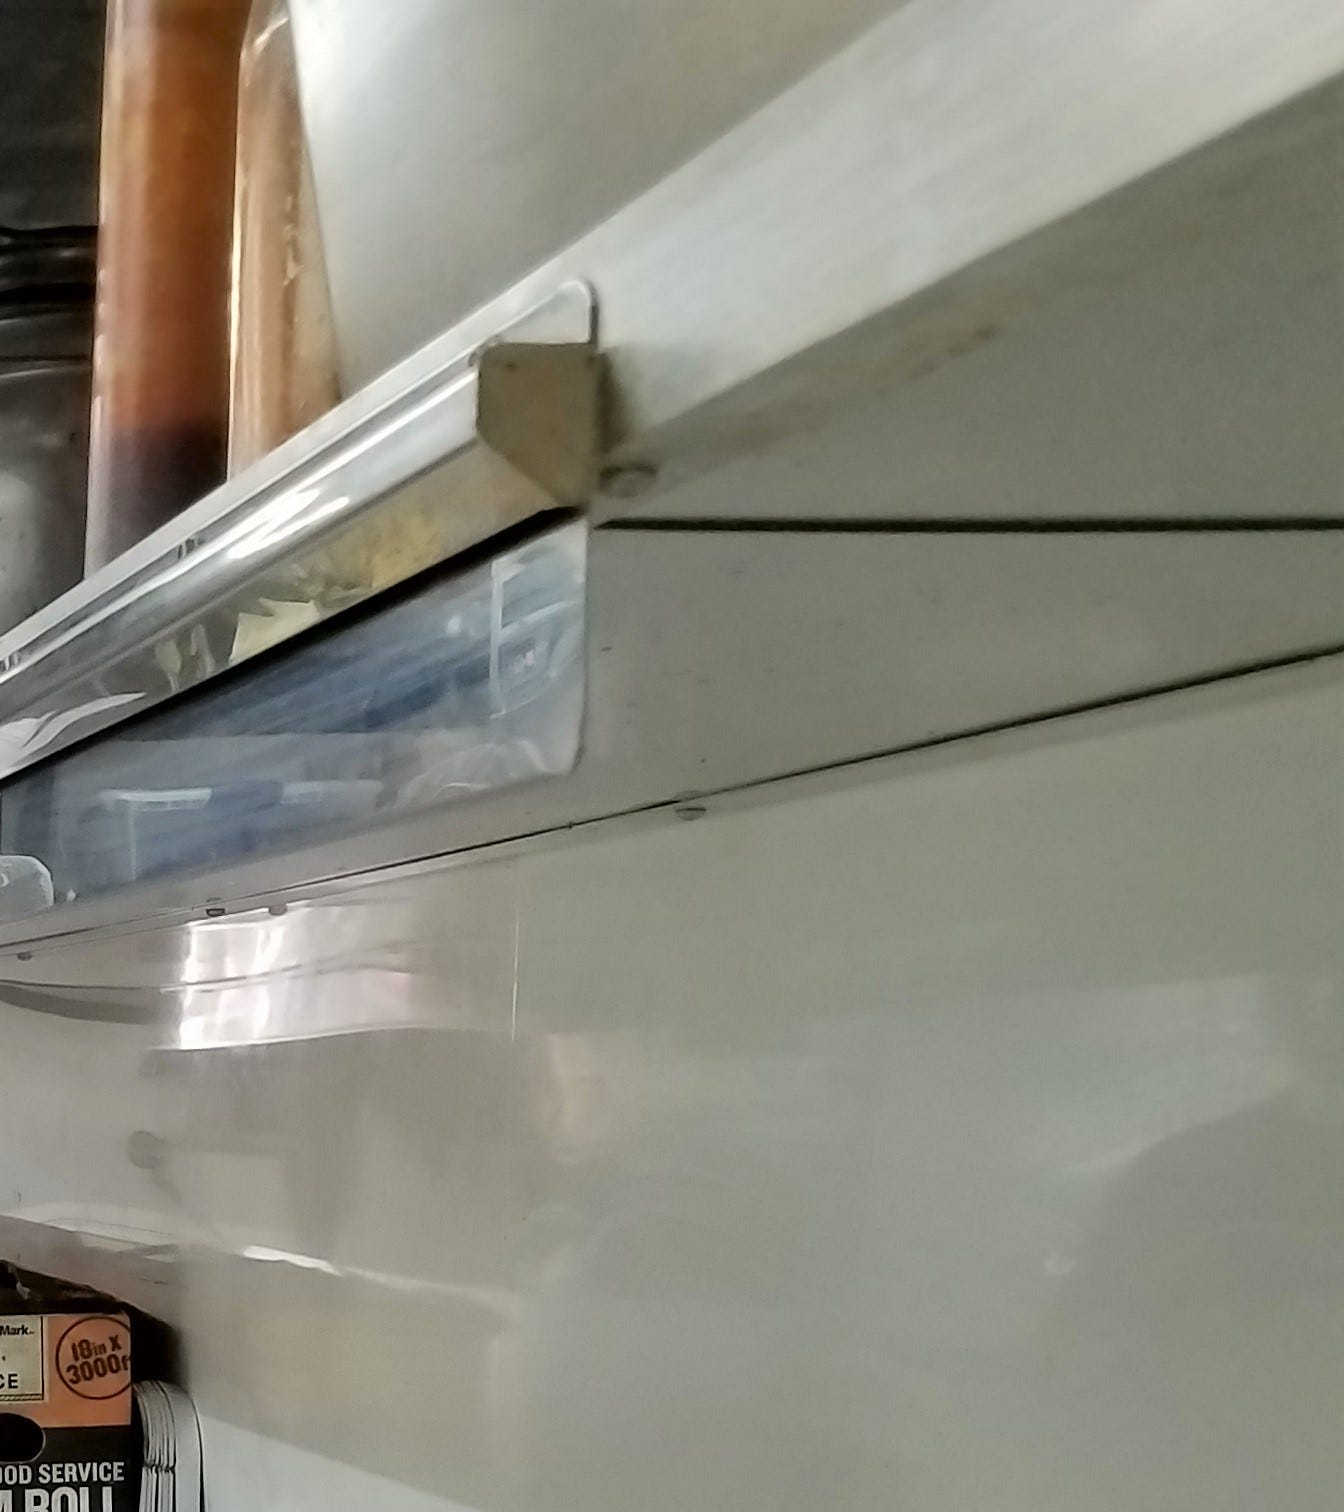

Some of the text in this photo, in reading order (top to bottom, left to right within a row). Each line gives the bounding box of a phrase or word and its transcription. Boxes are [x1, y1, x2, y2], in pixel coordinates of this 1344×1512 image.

[0, 1325, 29, 1336] Mark
[66, 1353, 129, 1385] 3000f
[38, 1461, 125, 1484] SERVICE
